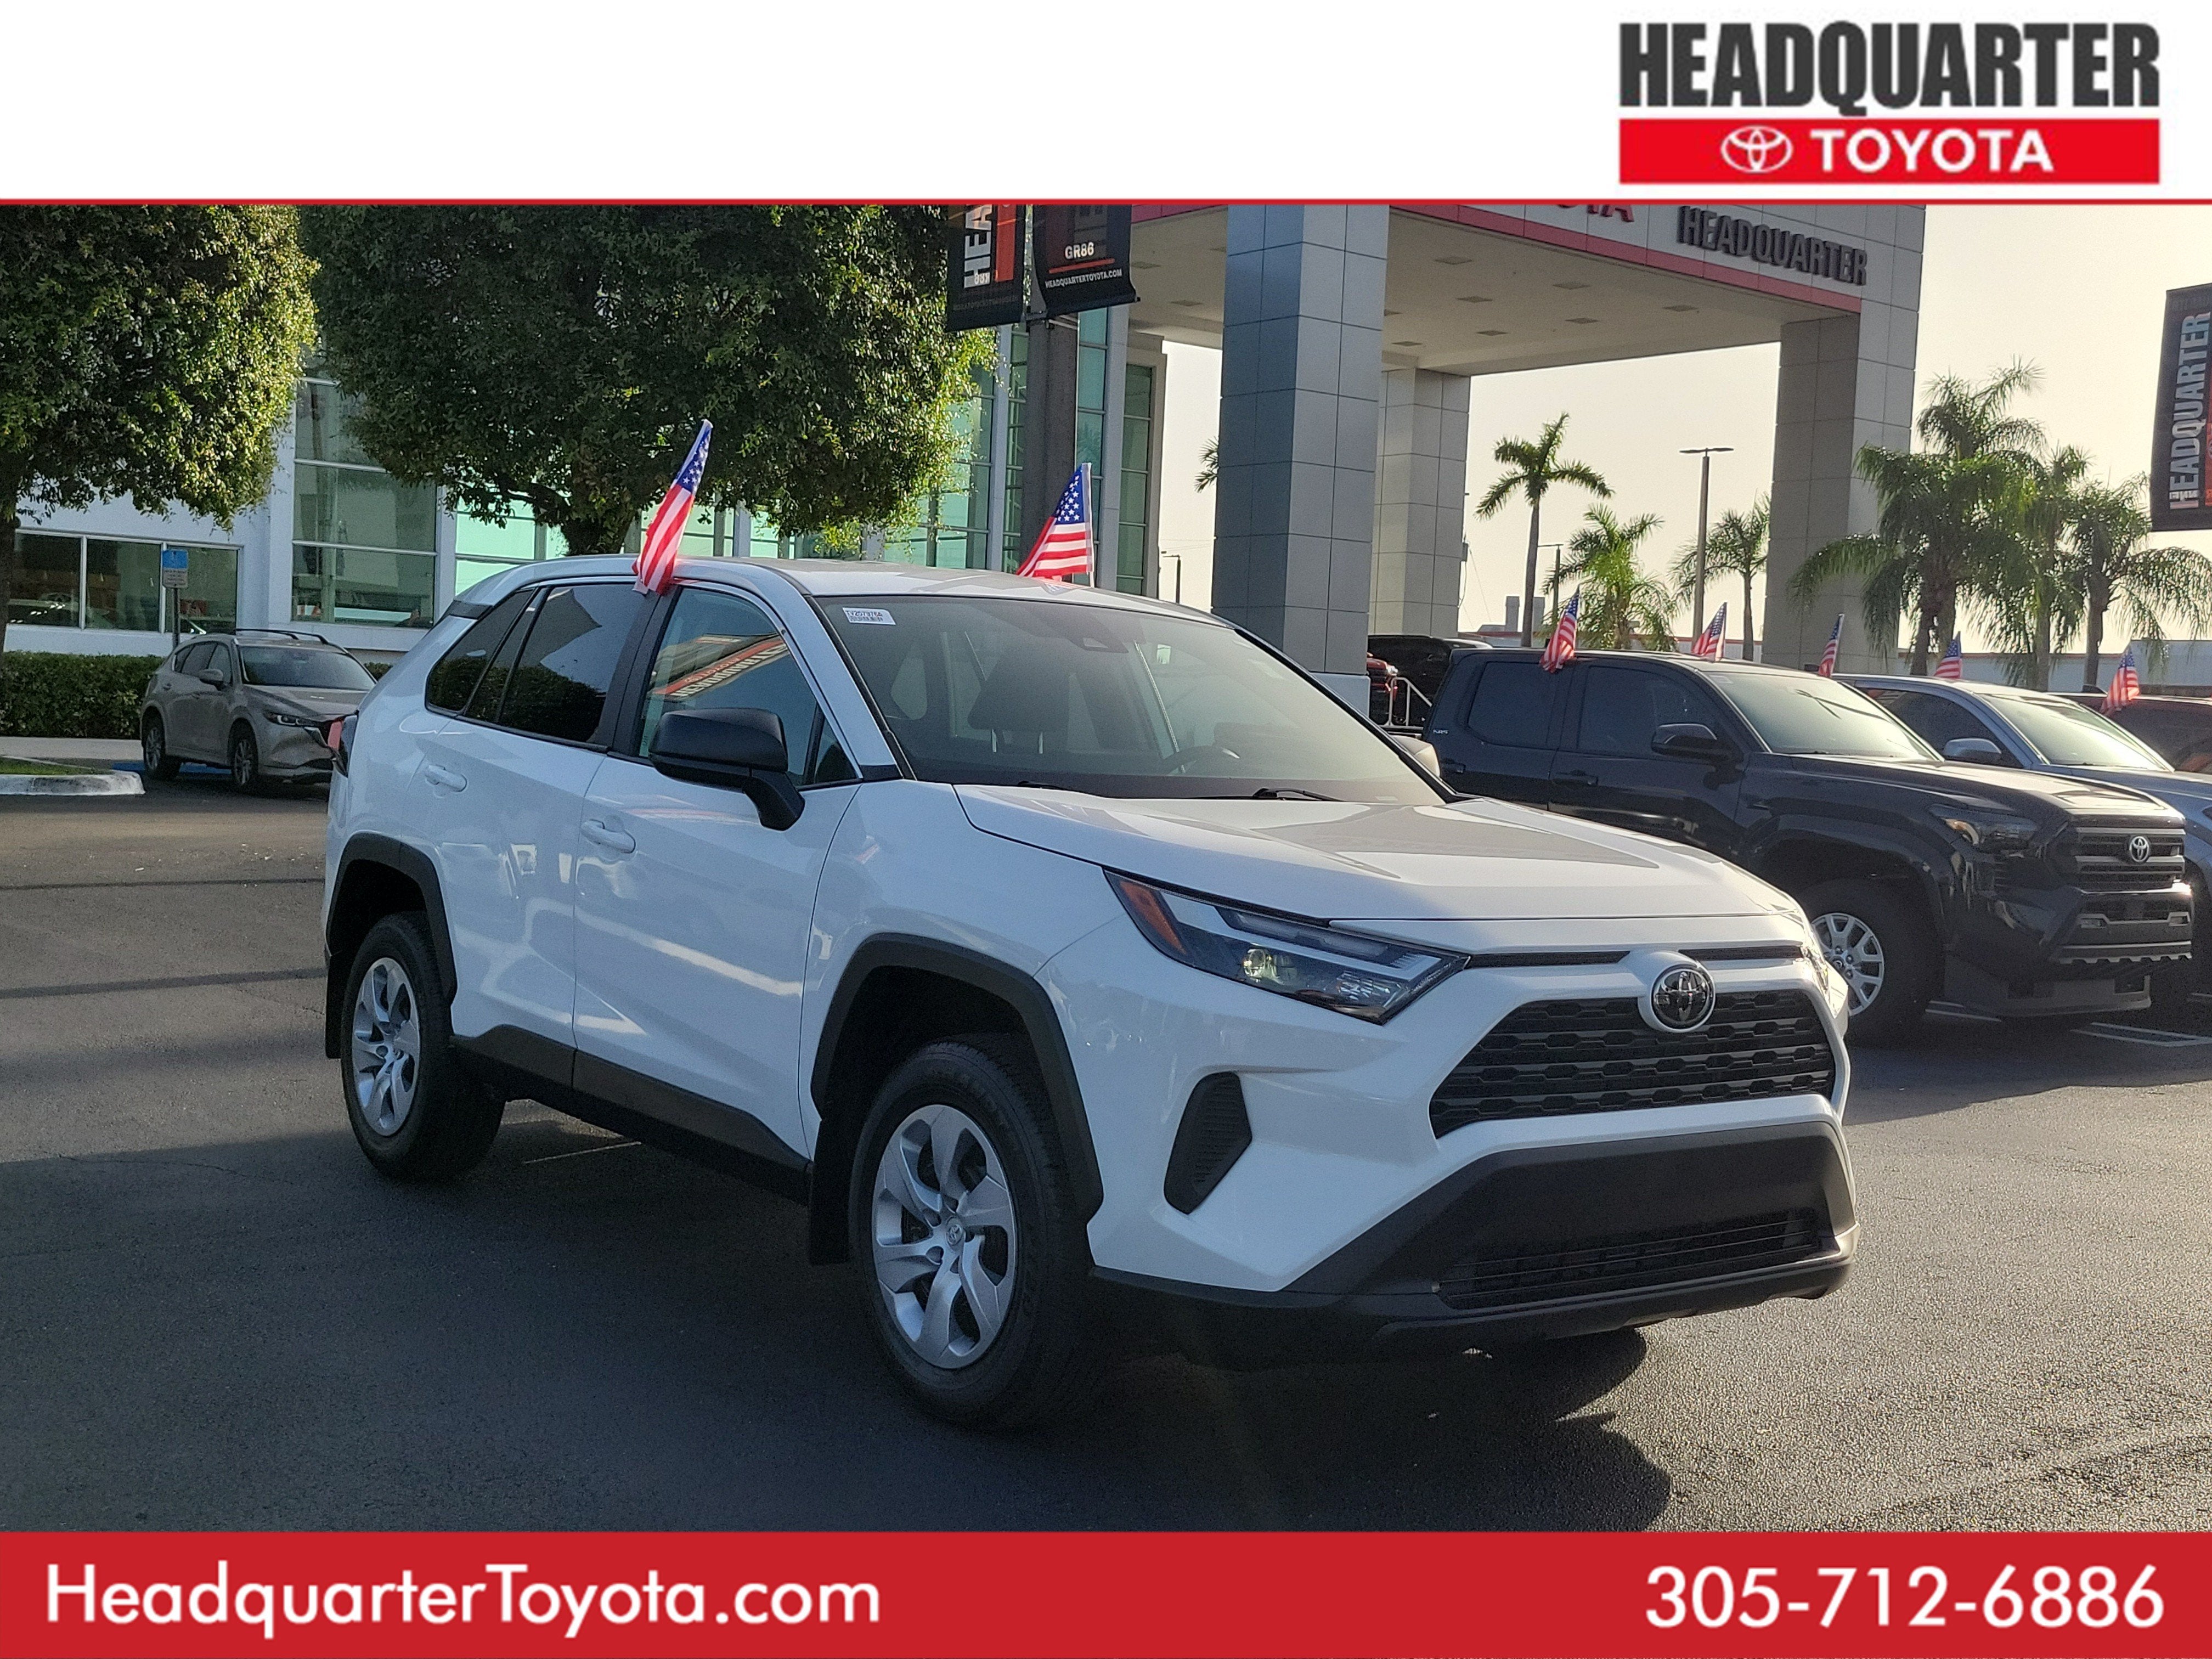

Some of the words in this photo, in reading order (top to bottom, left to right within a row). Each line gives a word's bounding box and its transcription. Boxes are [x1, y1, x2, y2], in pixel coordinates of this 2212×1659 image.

[1065, 241, 1095, 259] GR86
[1676, 205, 1867, 285] HEADQUARTER
[1045, 268, 1122, 289] HEADQUARTERTOYOTA.COM
[2169, 312, 2210, 510] HEADQUARTER
